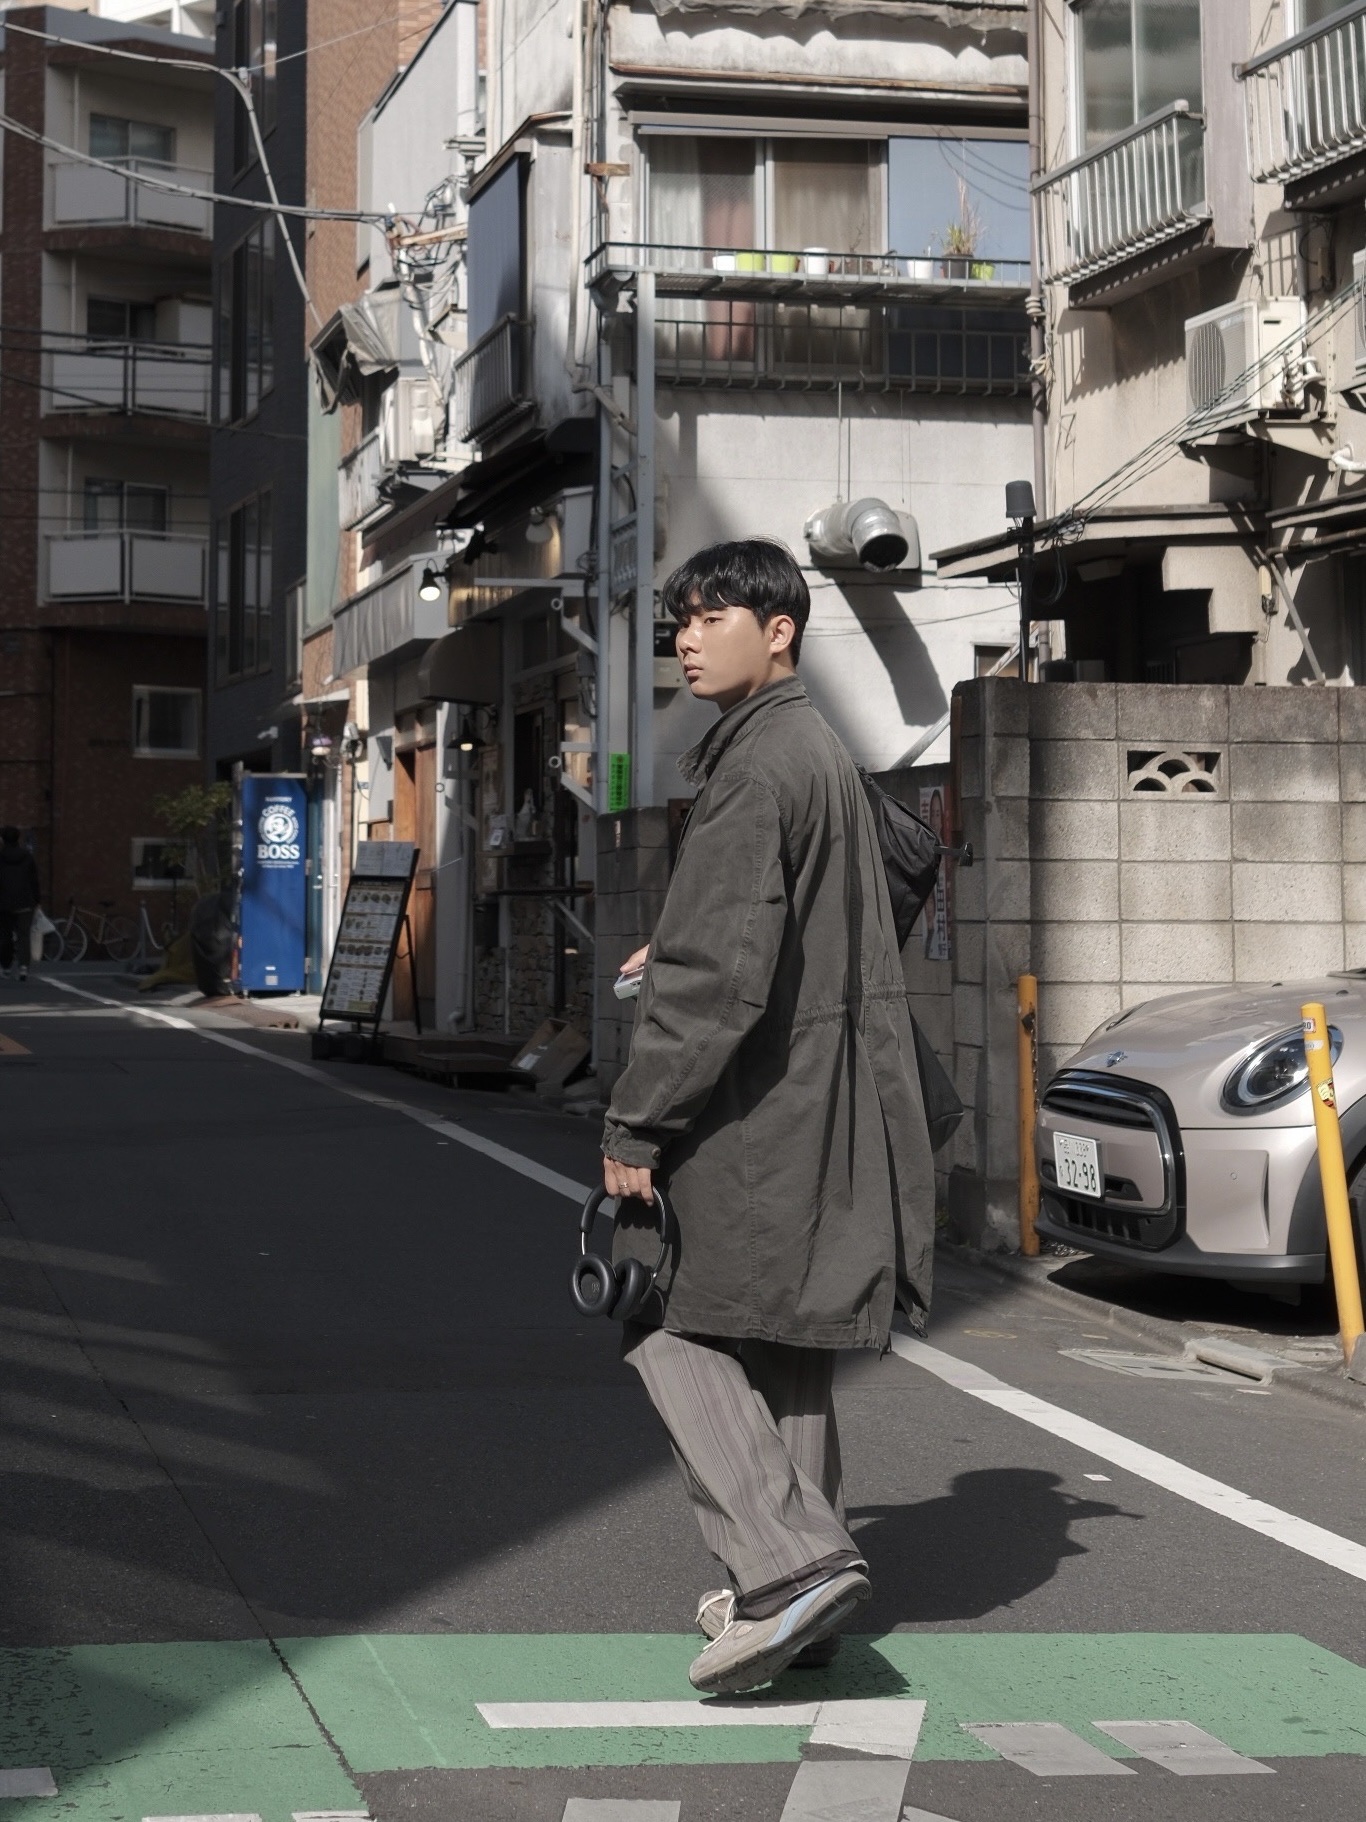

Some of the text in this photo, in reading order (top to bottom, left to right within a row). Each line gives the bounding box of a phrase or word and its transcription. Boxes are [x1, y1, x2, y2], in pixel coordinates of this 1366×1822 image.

[262, 804, 295, 817] COFFEE
[257, 844, 300, 859] BOSS
[1065, 1158, 1096, 1192] 32-98
